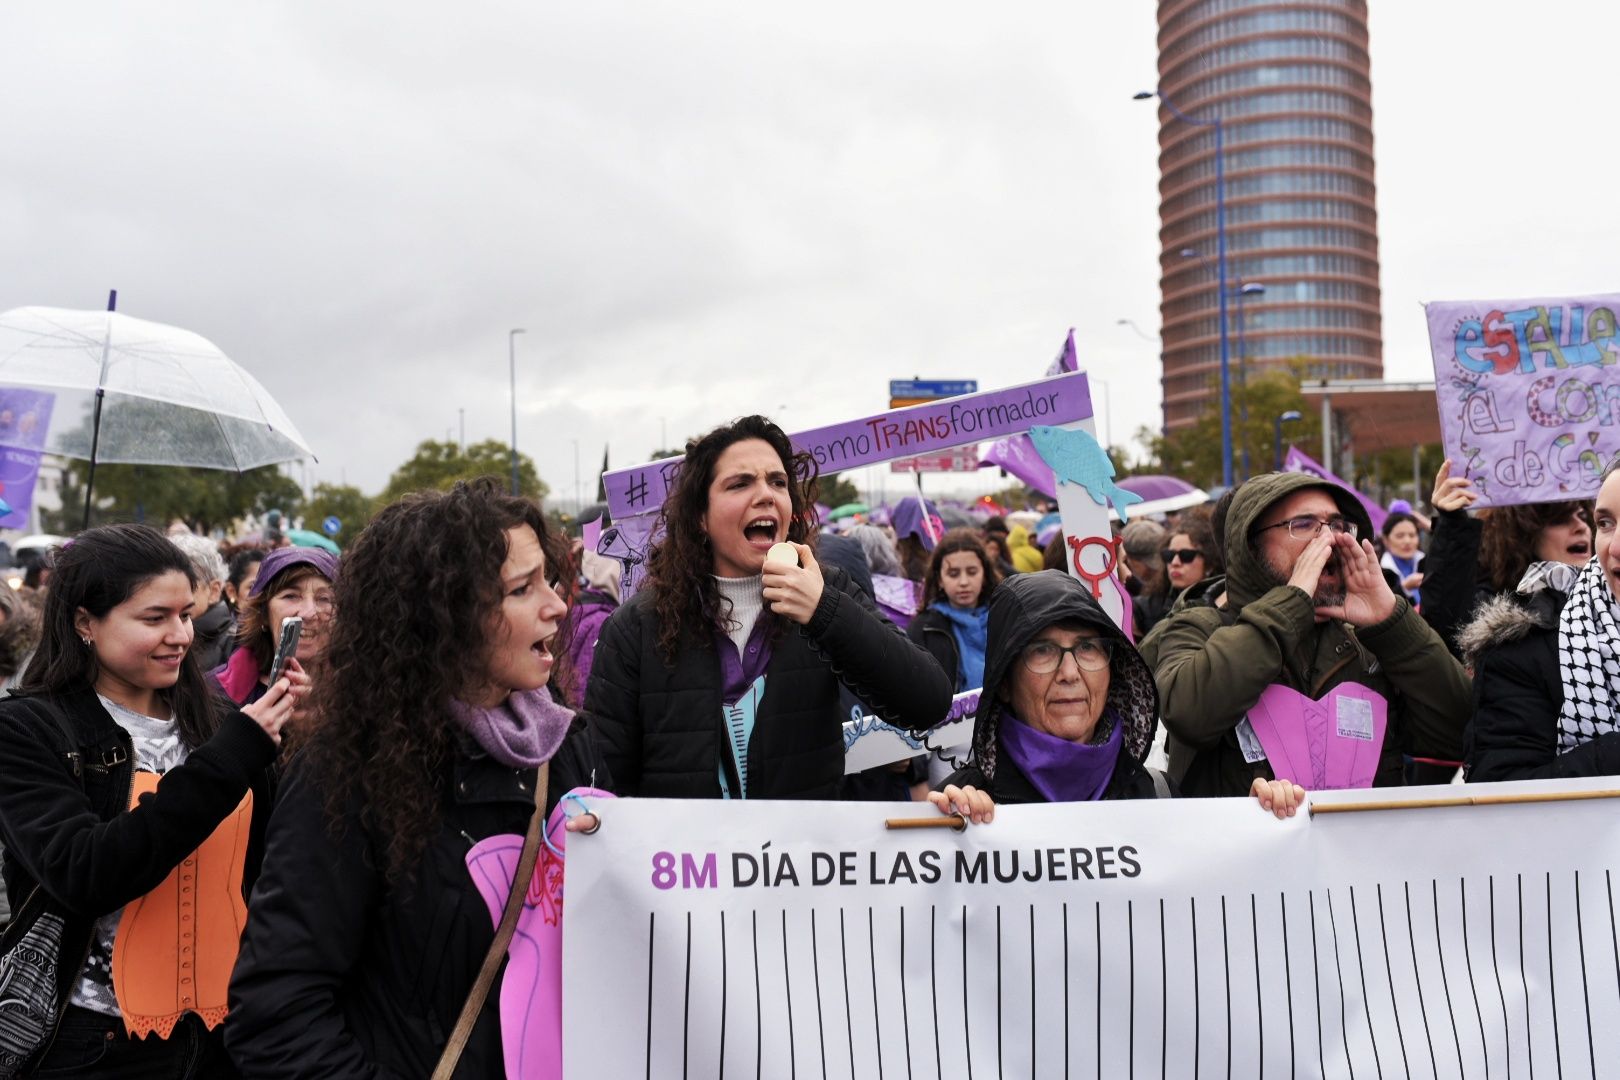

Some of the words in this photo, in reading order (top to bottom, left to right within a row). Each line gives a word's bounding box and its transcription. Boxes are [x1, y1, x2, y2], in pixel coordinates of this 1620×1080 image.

[1494, 440, 1545, 488] de
[650, 851, 718, 889] 8M
[732, 841, 800, 888] DÍA
[811, 851, 857, 886] DE
[869, 849, 942, 885] LAS
[954, 845, 1142, 884] MUJERES
